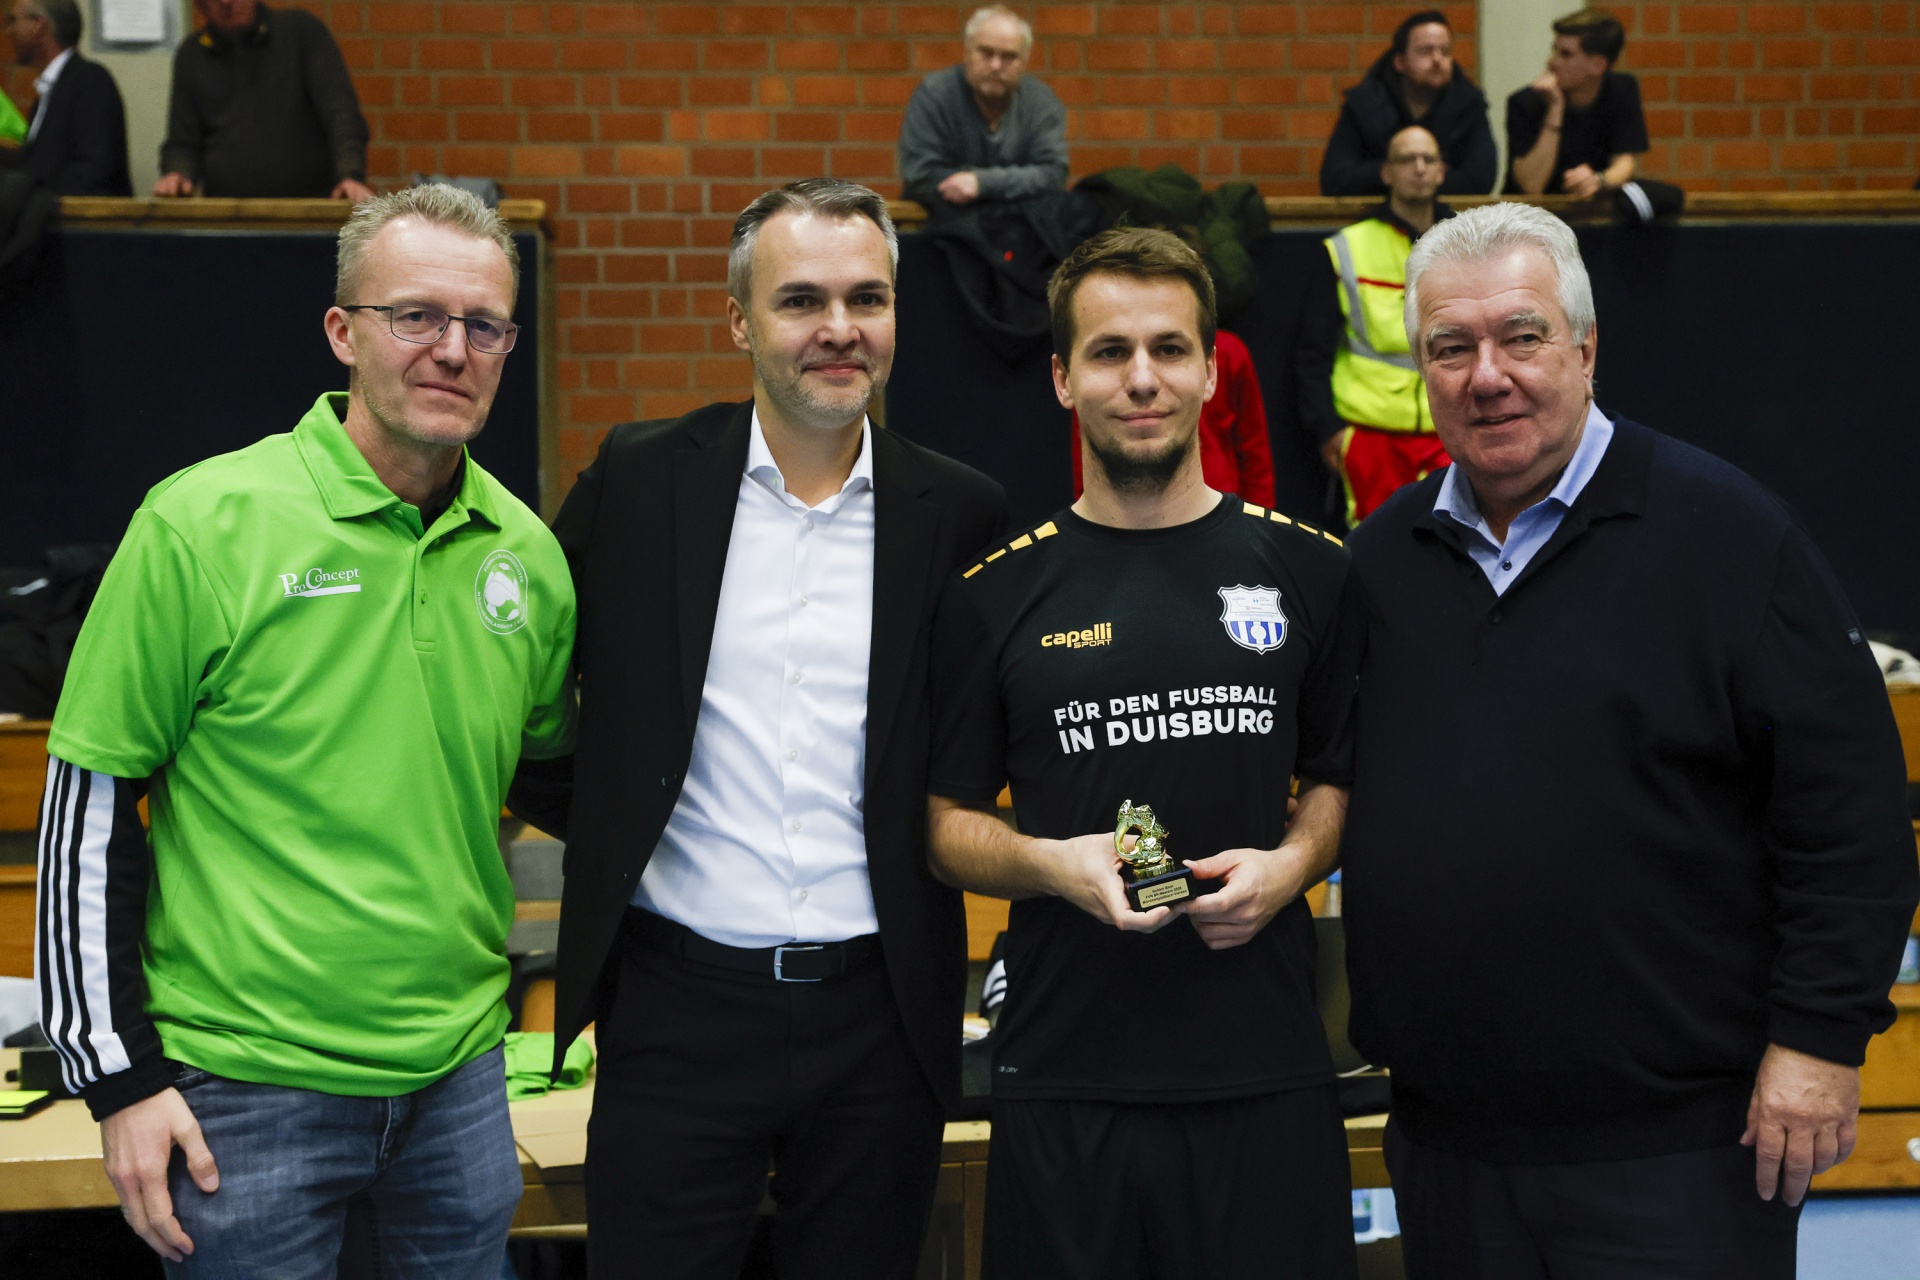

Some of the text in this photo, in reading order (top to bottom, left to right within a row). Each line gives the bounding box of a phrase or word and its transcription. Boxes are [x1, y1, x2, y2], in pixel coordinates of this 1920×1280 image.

[1041, 622, 1112, 648] capelli
[1073, 638, 1113, 649] SPORT
[1054, 685, 1277, 726] FÜR DEN FUSSBALL
[1059, 708, 1274, 754] IN DUISBURG
